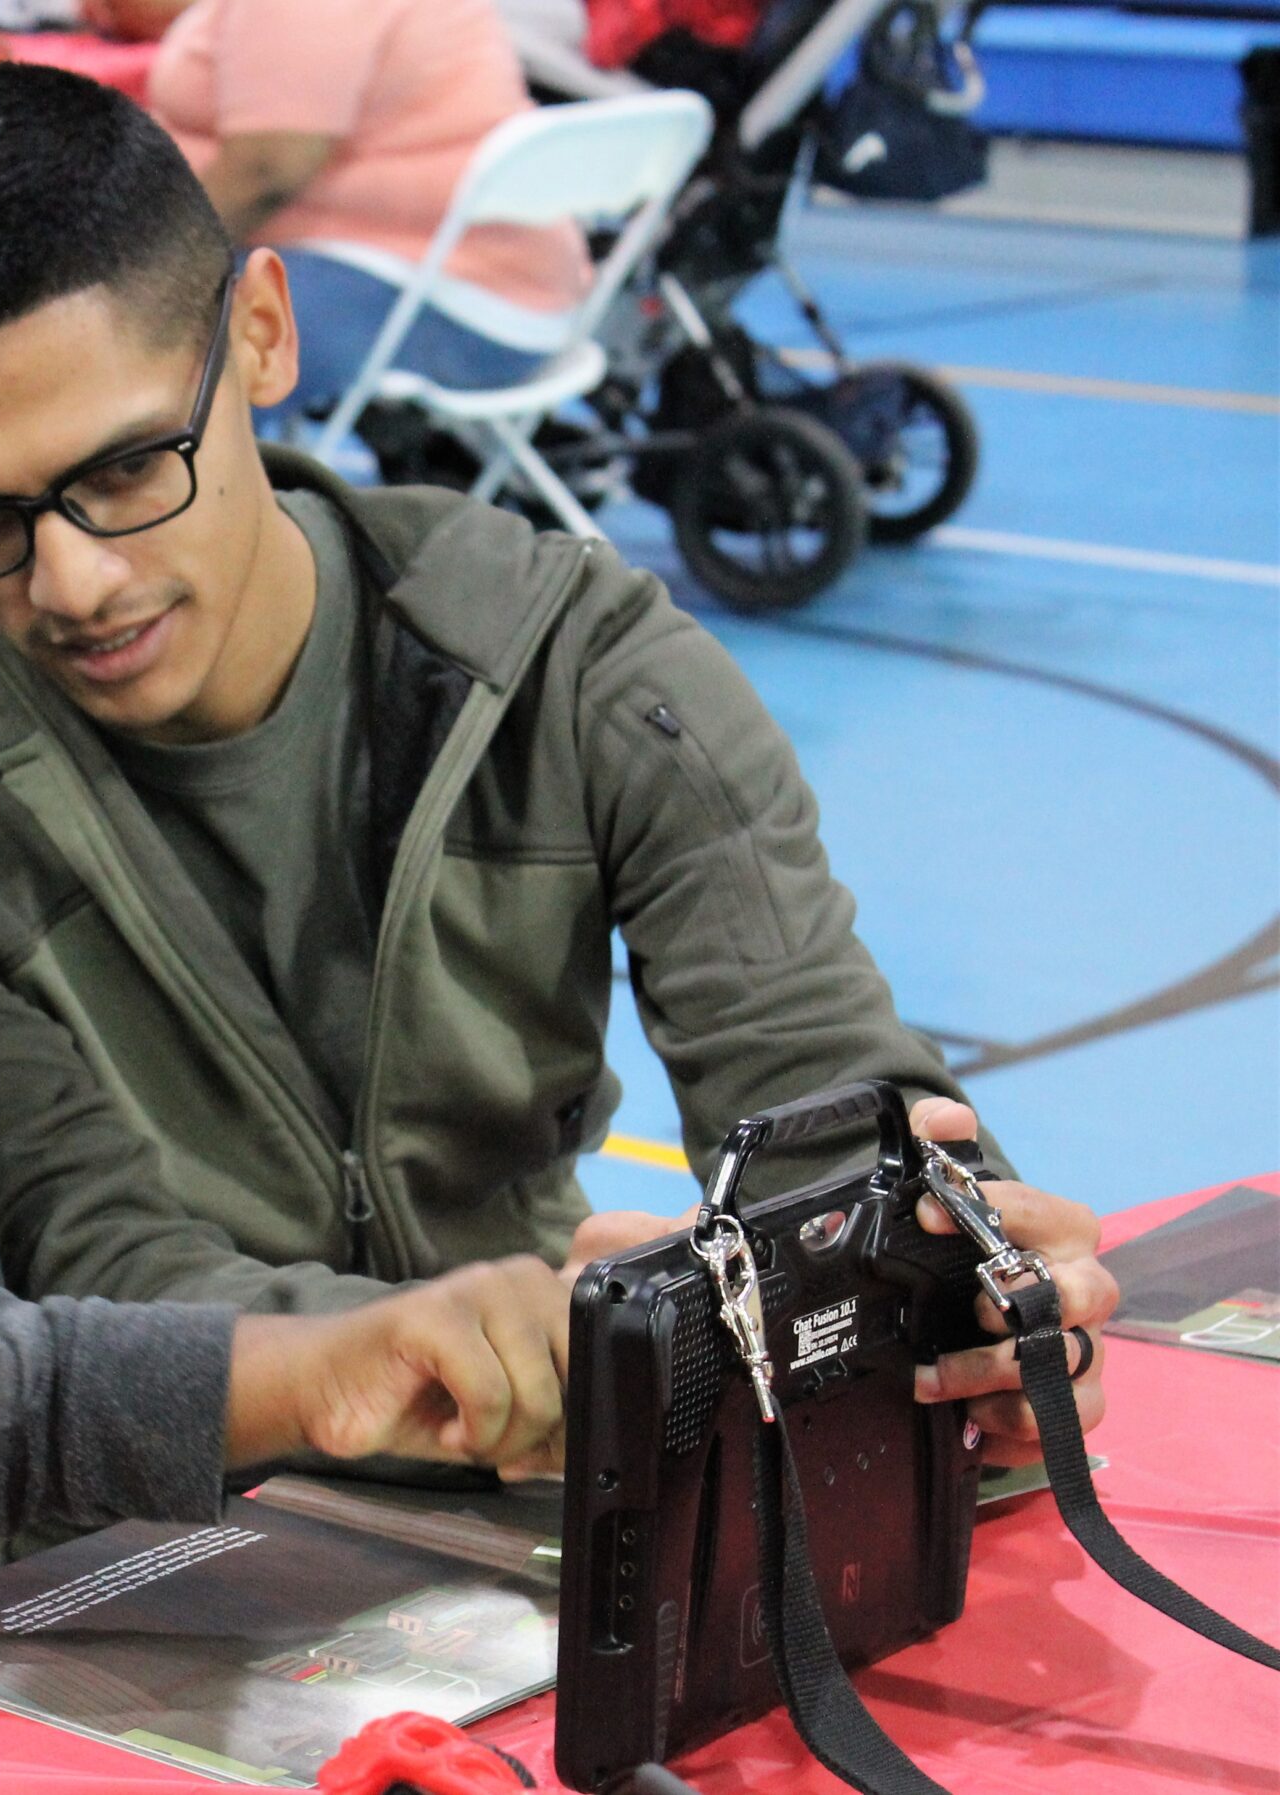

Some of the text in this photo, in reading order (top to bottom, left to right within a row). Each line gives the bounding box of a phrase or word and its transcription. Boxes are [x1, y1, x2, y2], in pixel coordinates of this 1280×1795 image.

[793, 1318, 812, 1334] Chat
[813, 1309, 839, 1327] Fusion
[840, 1299, 857, 1317] 10.1
